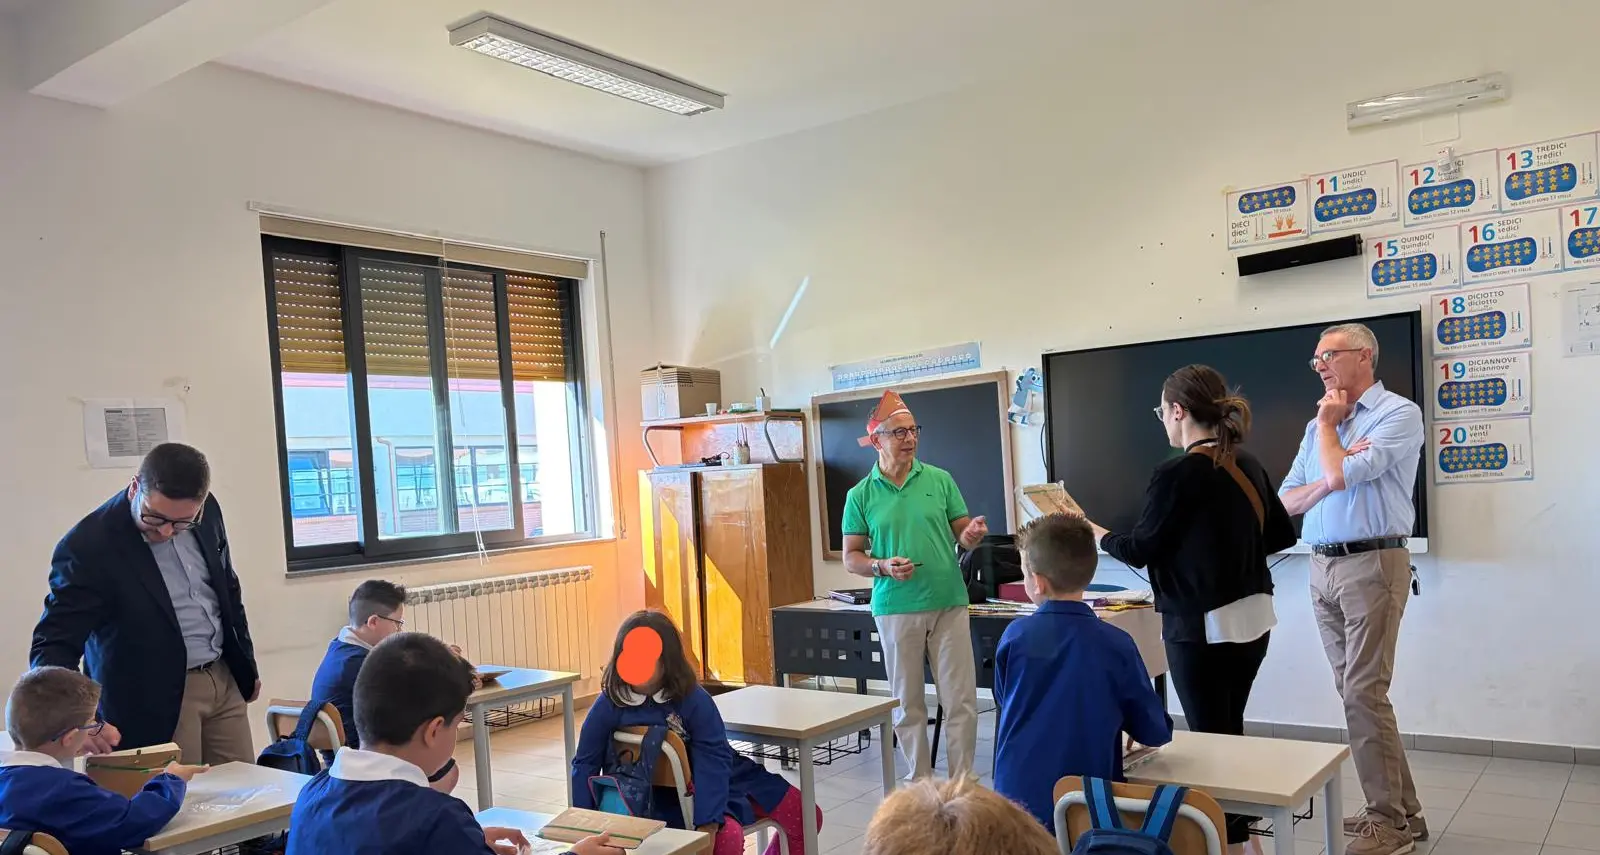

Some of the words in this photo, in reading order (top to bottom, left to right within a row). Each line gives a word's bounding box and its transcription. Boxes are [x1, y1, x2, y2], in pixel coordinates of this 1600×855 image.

[1536, 142, 1567, 153] TREDICI
[1507, 150, 1533, 170] 13
[1536, 151, 1562, 160] tredici
[1342, 170, 1366, 179] UNDICI
[1410, 166, 1435, 186] 12
[1316, 176, 1337, 194] 11
[1342, 177, 1363, 185] undici
[1498, 218, 1522, 226] SEDICI
[1570, 207, 1598, 226] 17
[1232, 221, 1250, 229] DIECI
[1498, 225, 1519, 233] sedici
[1232, 229, 1248, 237] dieci
[1401, 232, 1434, 243] QUINDICI
[1468, 223, 1496, 243] 16
[1374, 240, 1398, 258] 15
[1401, 241, 1430, 250] quindici
[1468, 290, 1504, 300] DICIOTTO
[1440, 297, 1465, 315] 18
[1469, 357, 1517, 365] DICIANNOVE
[1440, 362, 1465, 379] 19
[1440, 427, 1466, 445] 20
